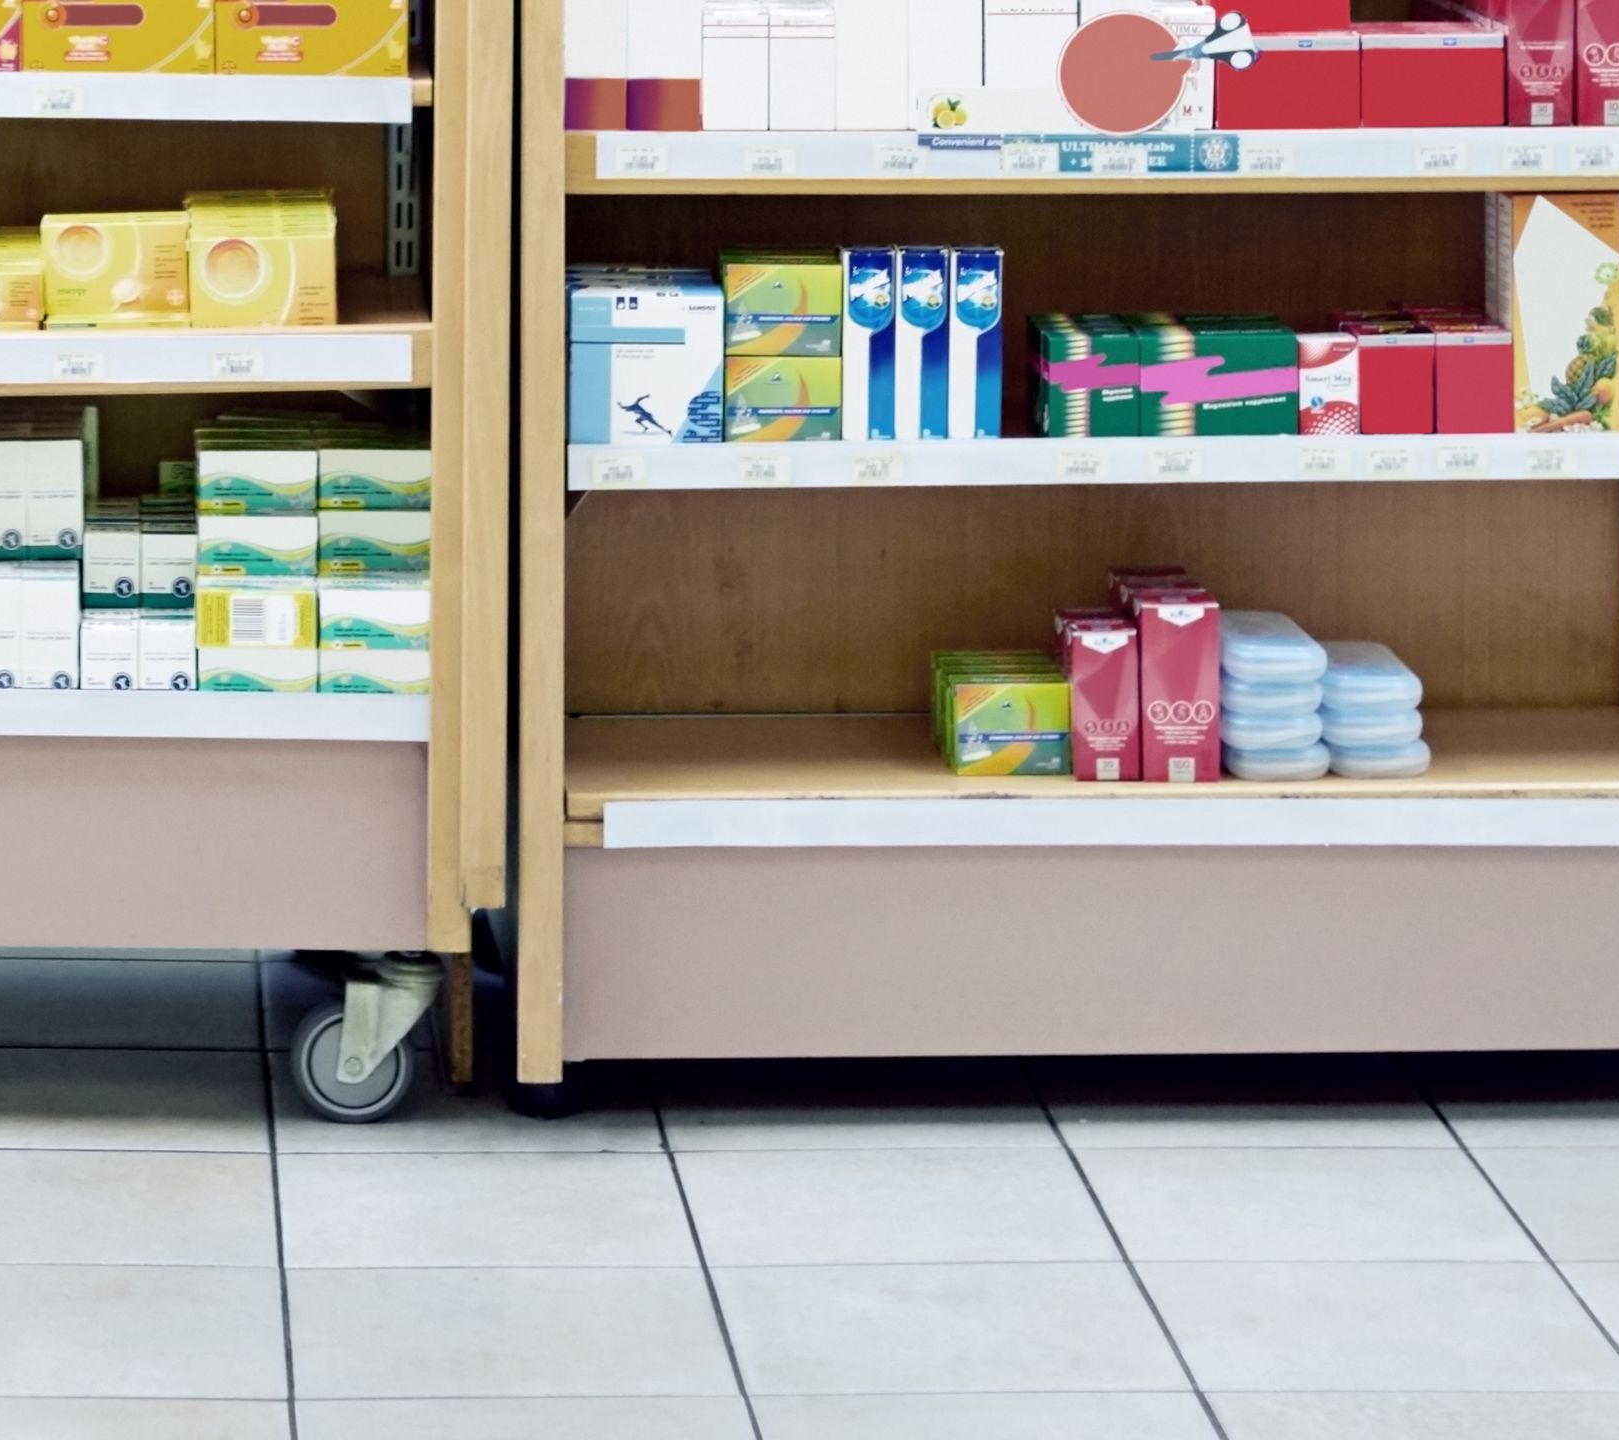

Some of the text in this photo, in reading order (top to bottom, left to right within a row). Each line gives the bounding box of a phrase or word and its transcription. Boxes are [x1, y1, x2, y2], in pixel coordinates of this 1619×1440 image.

[932, 138, 980, 147] Convenient
[1203, 396, 1286, 411] Magnesium supplement
